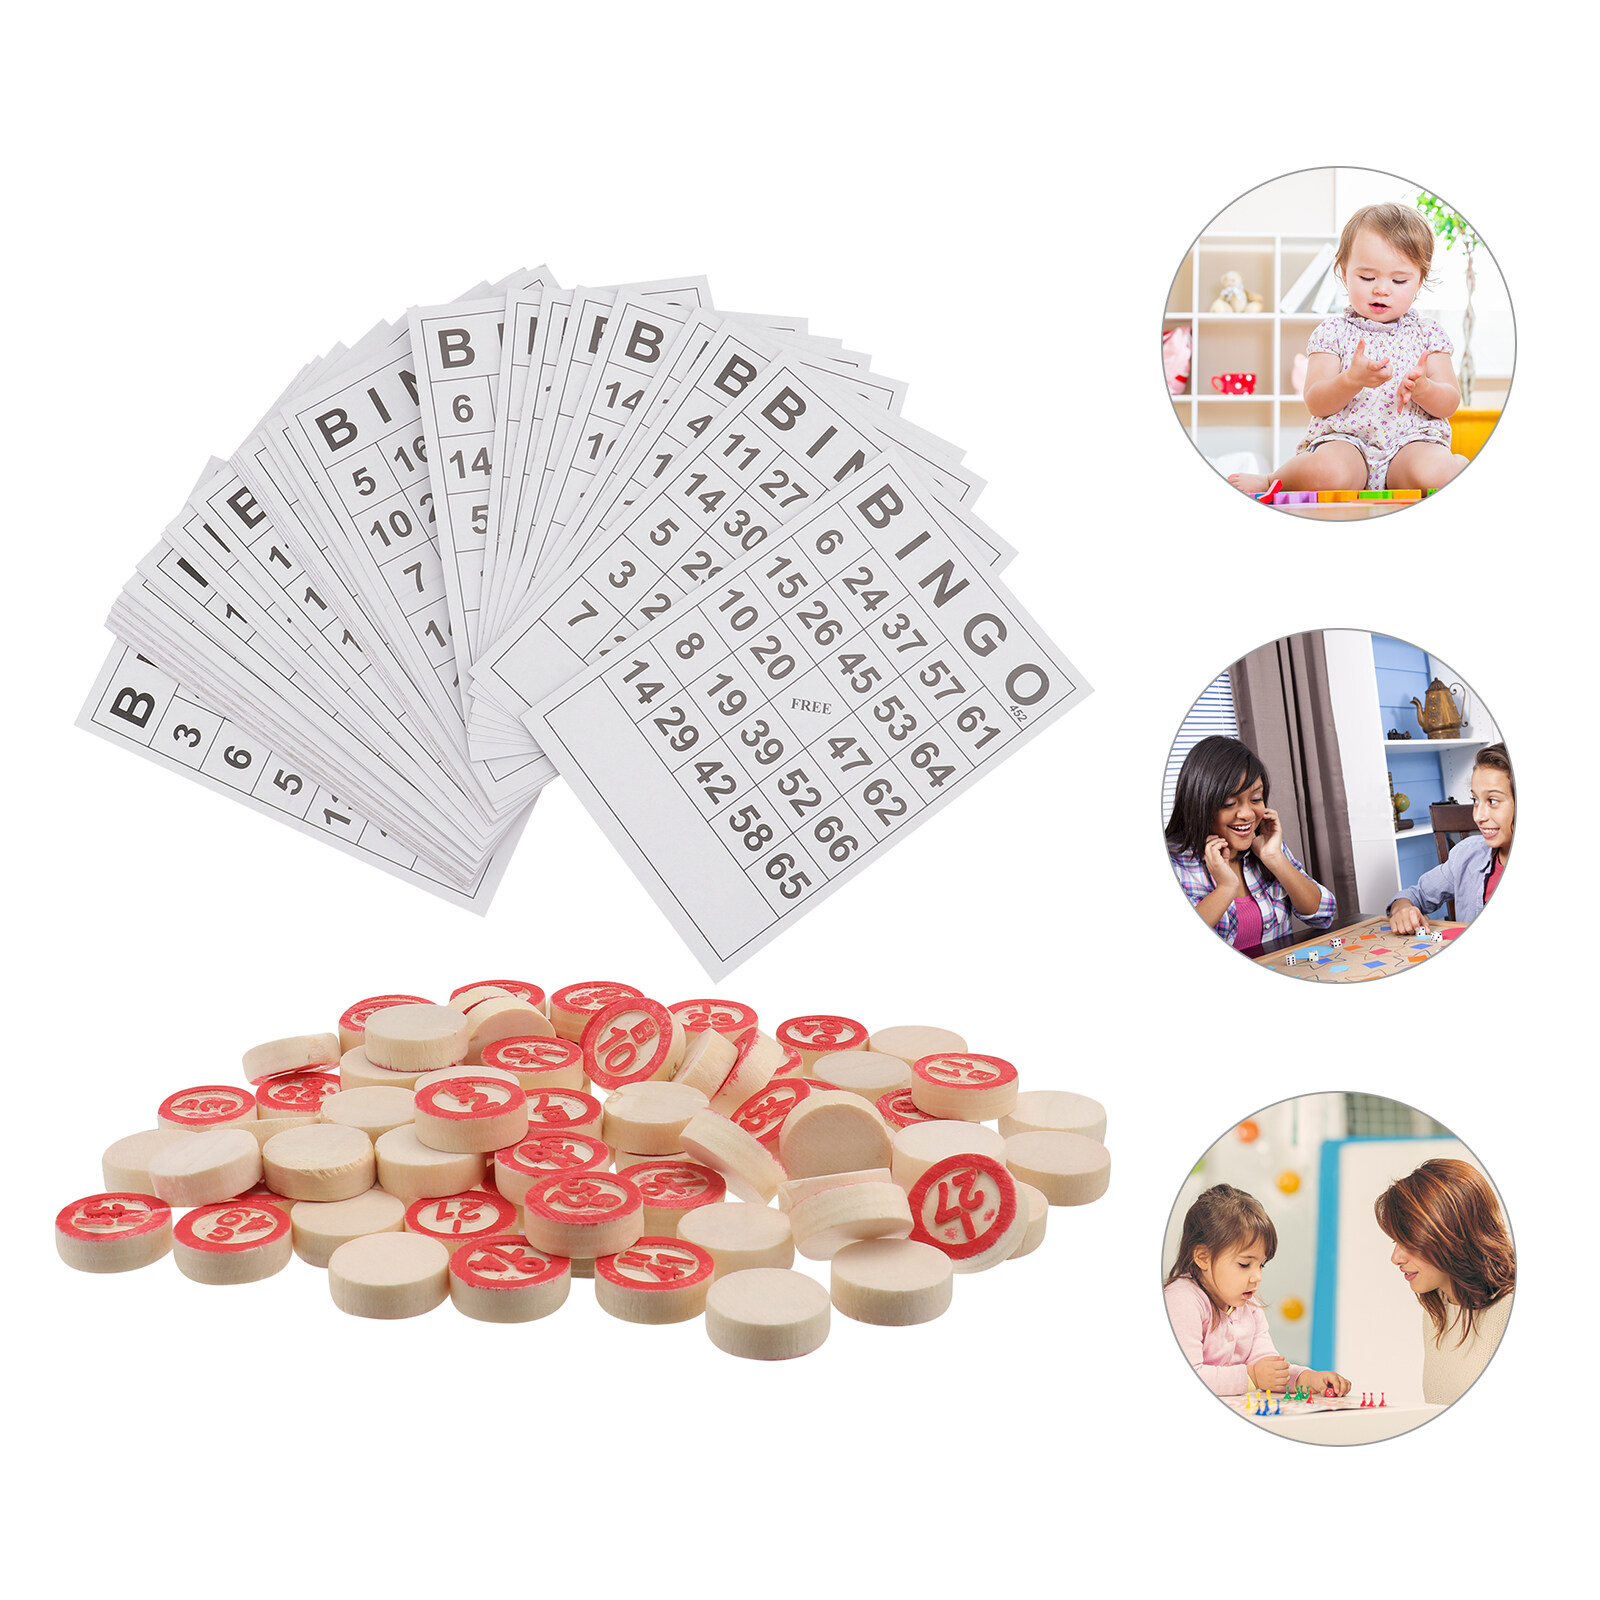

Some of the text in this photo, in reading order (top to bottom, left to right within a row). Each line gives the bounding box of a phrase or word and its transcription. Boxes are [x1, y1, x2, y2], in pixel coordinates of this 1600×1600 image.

[624, 319, 664, 364] B
[713, 353, 758, 399] B
[452, 394, 474, 423] 6
[605, 381, 646, 415] 14
[449, 446, 493, 479] 14
[722, 433, 810, 509] 11 27
[351, 466, 377, 496] 5
[471, 504, 489, 535] 5
[684, 472, 768, 552] 14 30
[369, 510, 413, 547] 10
[649, 517, 680, 547] 5
[402, 561, 425, 593] 7
[608, 560, 637, 589] 3
[567, 599, 600, 627] 7
[815, 529, 1001, 750] 6 24 37 57 61
[765, 556, 957, 788] 15 26 45 53 64
[109, 686, 156, 729] B
[718, 588, 908, 827] 10 20 FREE 47 62
[1009, 705, 1028, 723] 452
[172, 723, 202, 748] 3
[675, 632, 859, 863] 8 19 39 52 66
[223, 745, 252, 770] 6
[272, 768, 303, 796] 5
[622, 659, 813, 900] 14 29 42 58 65
[631, 1018, 660, 1044] B
[686, 1012, 736, 1028] 23
[597, 1026, 638, 1073] 10
[931, 1058, 974, 1078] 11
[967, 1068, 997, 1081] B
[435, 1199, 485, 1222] 21
[934, 1168, 985, 1224] 27
